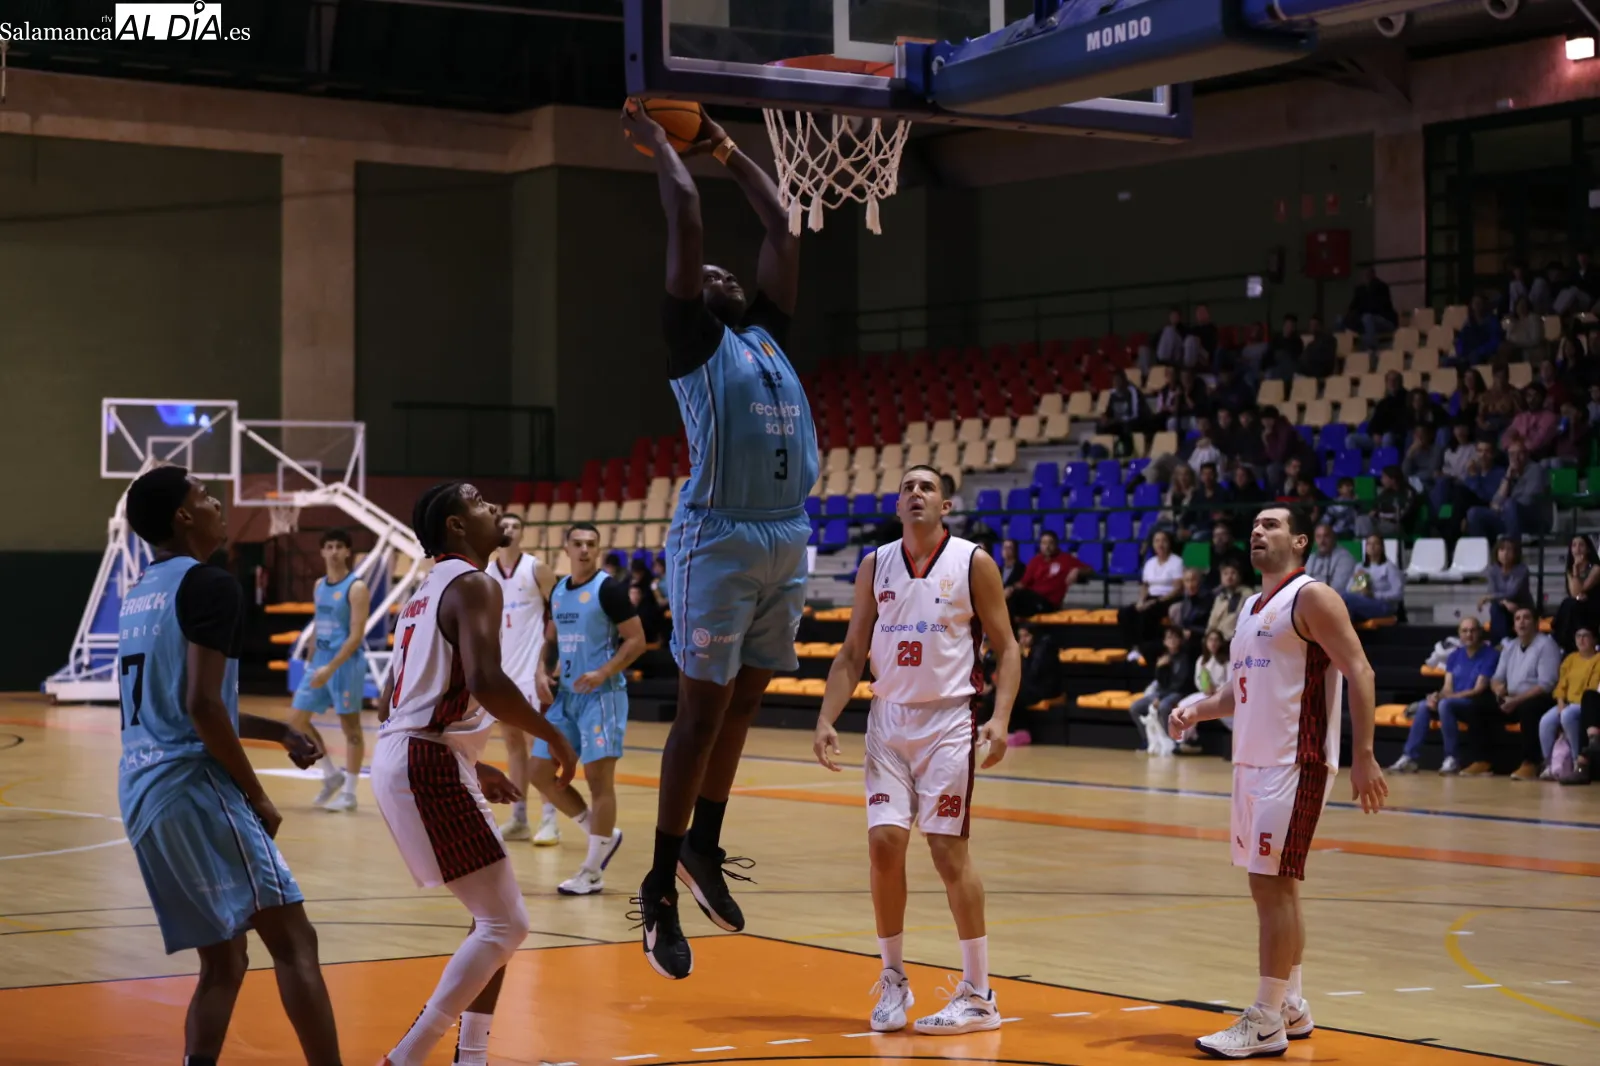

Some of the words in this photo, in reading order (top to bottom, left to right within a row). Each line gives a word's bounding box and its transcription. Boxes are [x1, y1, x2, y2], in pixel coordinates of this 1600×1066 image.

[1086, 16, 1151, 52] MONDO
[765, 418, 794, 435] sad
[774, 449, 788, 480] 3
[930, 624, 948, 633] 2027
[897, 640, 922, 667] 29
[120, 653, 145, 731] 7
[1239, 677, 1247, 703] 5
[937, 794, 962, 817] 29
[1258, 832, 1272, 856] 5
